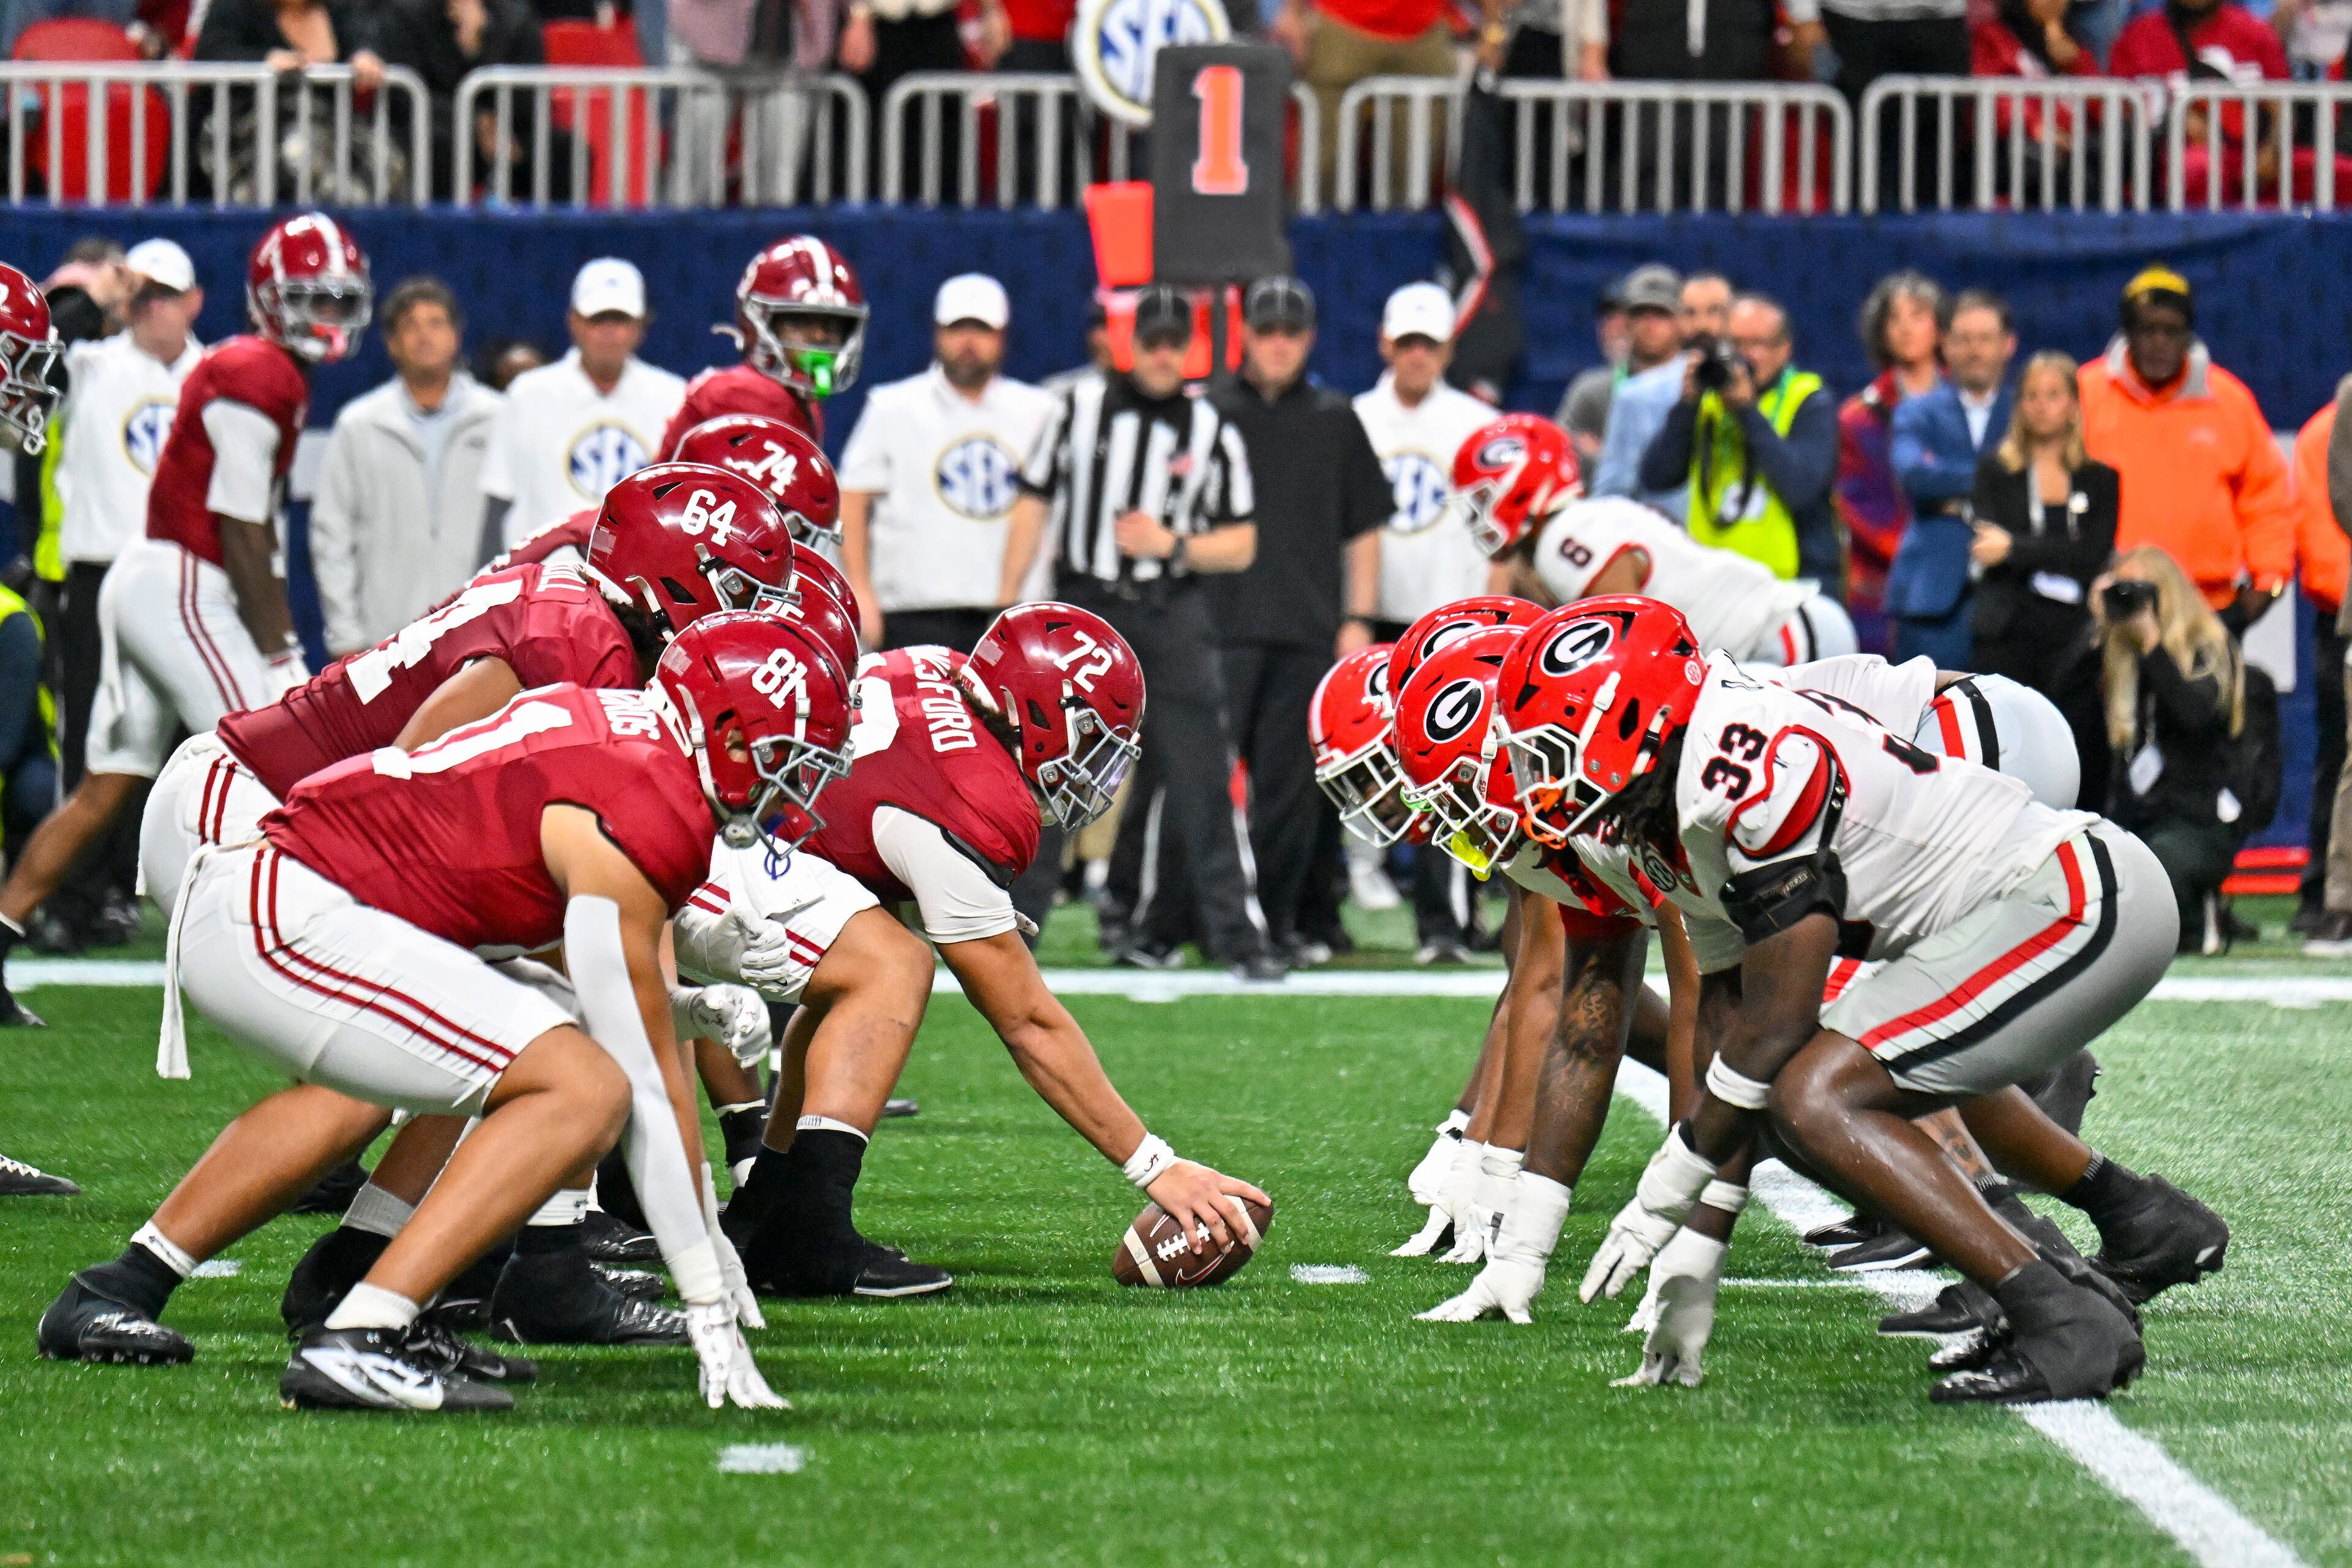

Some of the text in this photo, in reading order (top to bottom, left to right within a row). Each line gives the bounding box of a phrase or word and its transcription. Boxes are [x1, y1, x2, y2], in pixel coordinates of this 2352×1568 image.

[1191, 65, 1248, 195] 1
[747, 440, 798, 496] 74
[940, 439, 1018, 514] SEC
[680, 489, 737, 547] 64
[752, 647, 809, 709] 81
[1053, 629, 1113, 693] 72
[1540, 618, 1614, 677] G
[1424, 679, 1485, 743] G
[1700, 722, 1769, 802] 33
